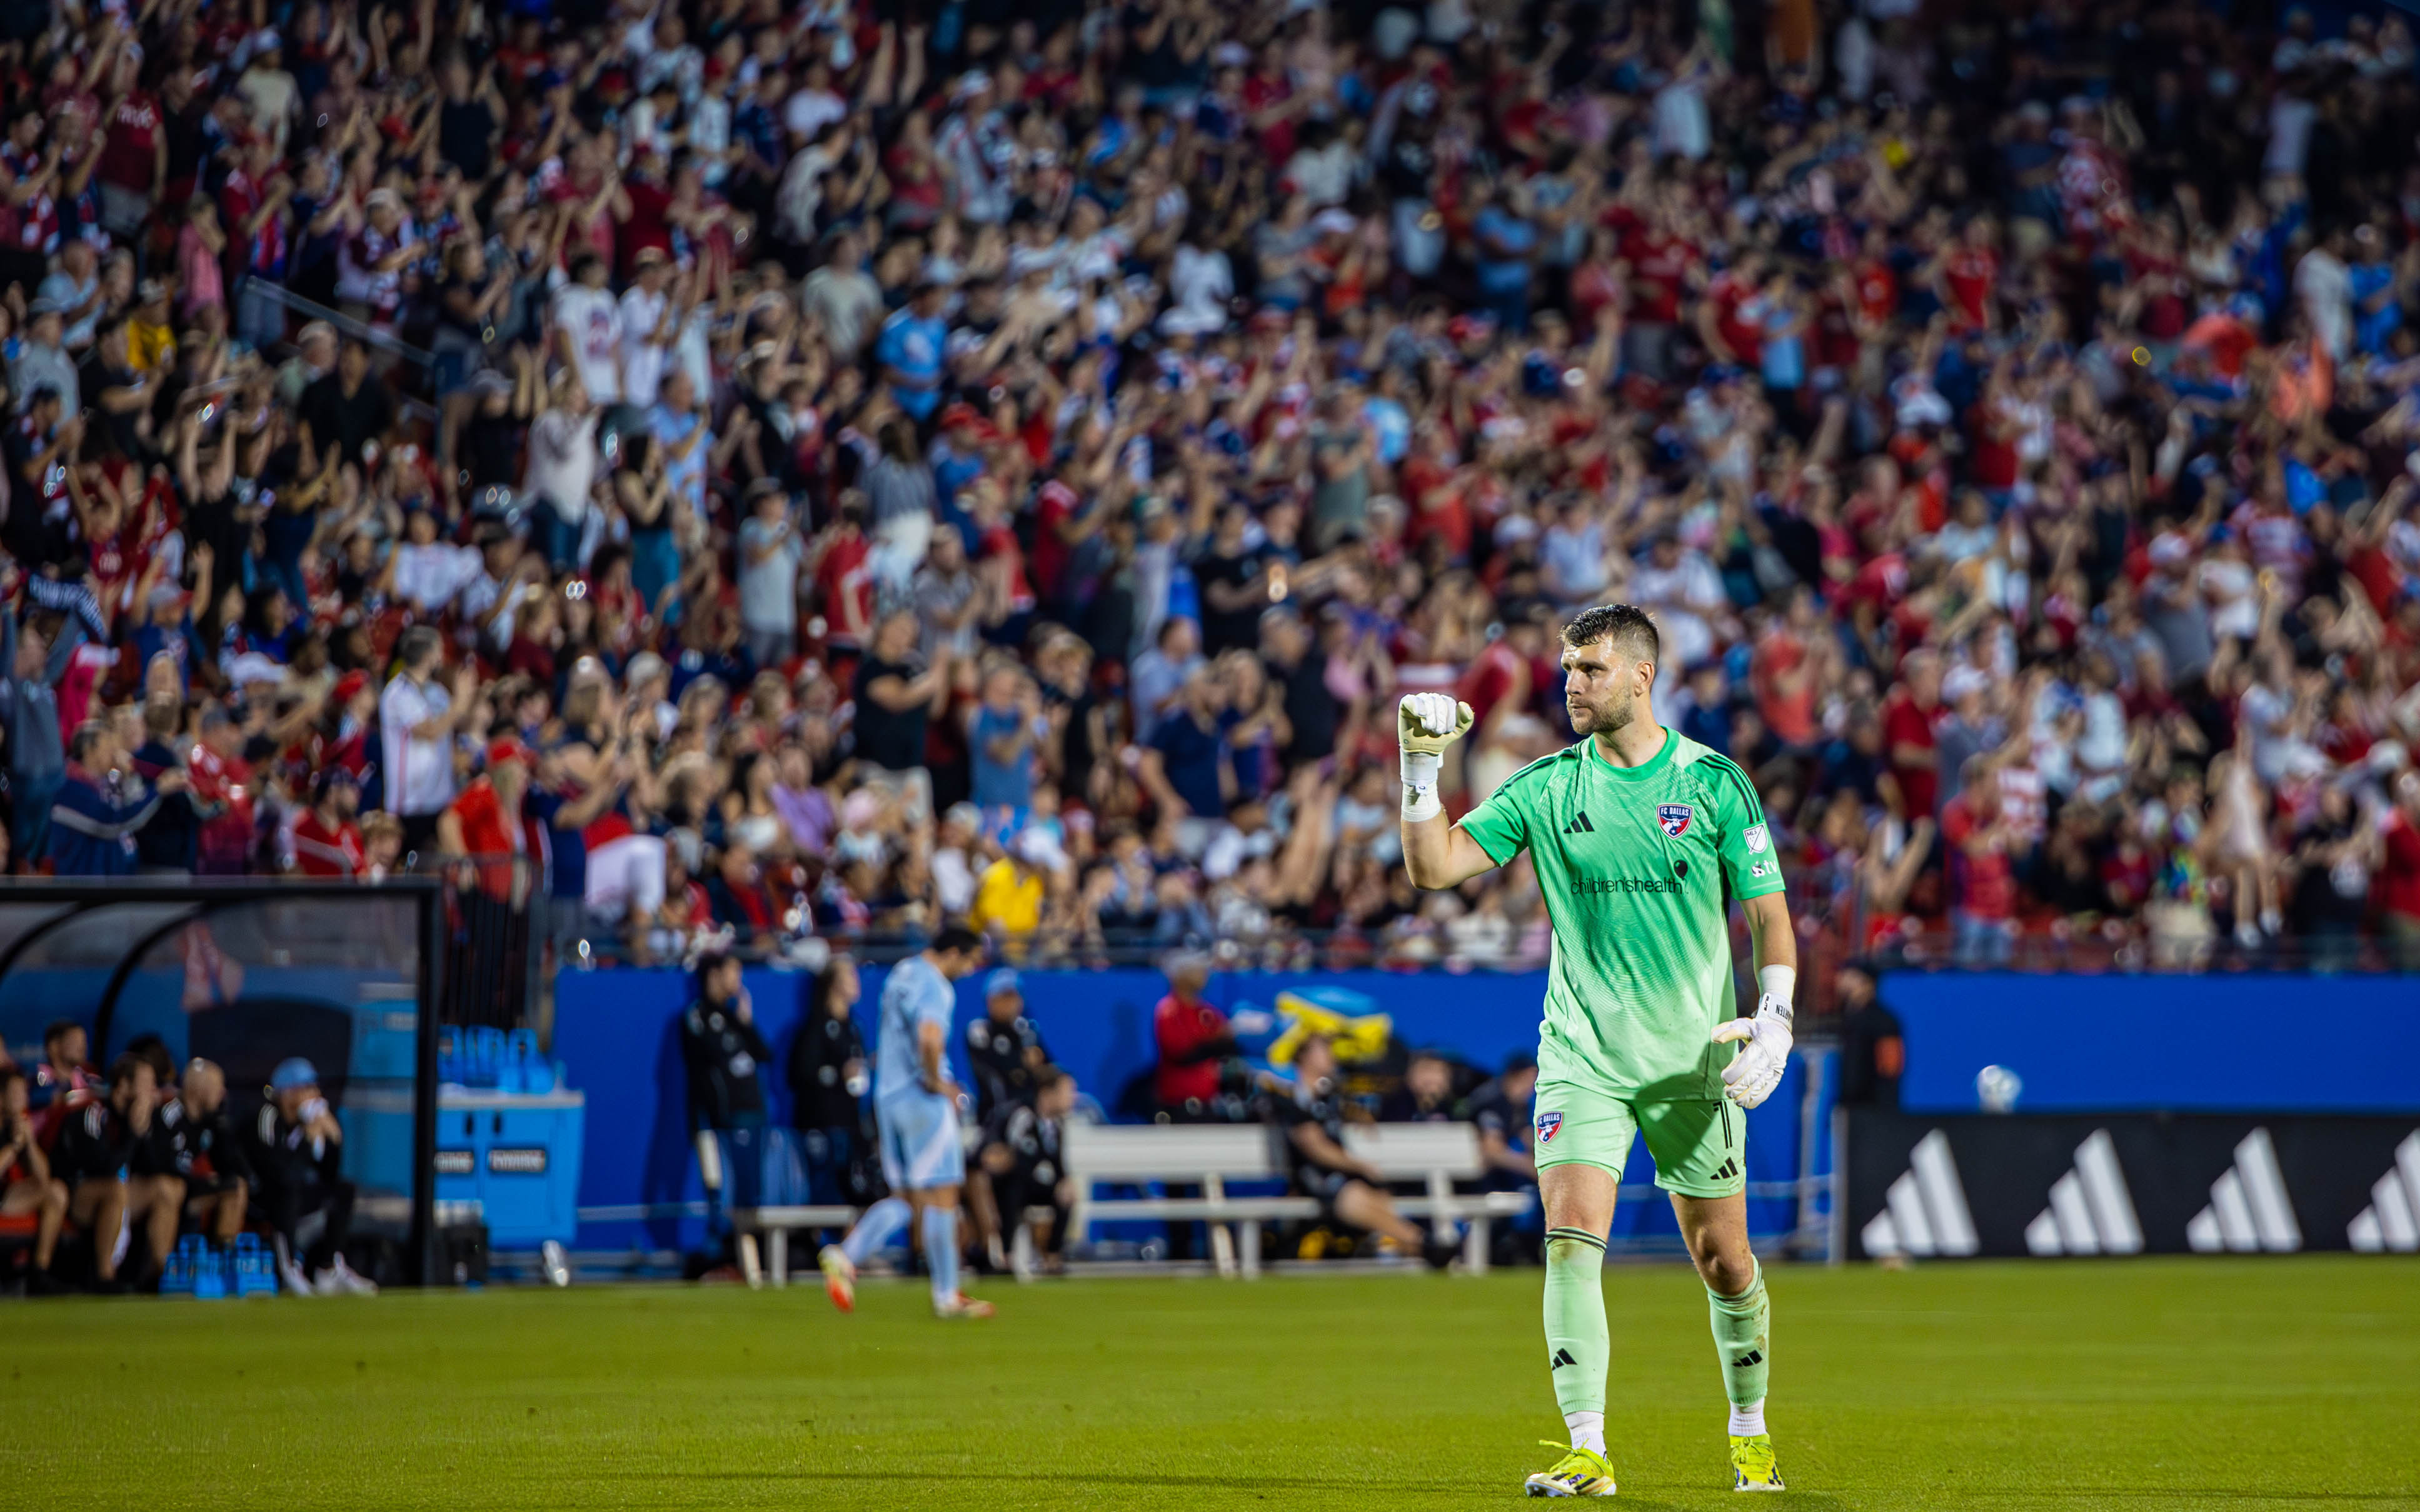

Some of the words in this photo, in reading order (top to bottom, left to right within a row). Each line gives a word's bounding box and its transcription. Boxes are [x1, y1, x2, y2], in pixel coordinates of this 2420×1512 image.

[1660, 807, 1668, 815] FC
[1669, 806, 1689, 816] DALLAS
[1763, 859, 1777, 874] tv
[1543, 1113, 1560, 1123] DALLAS
